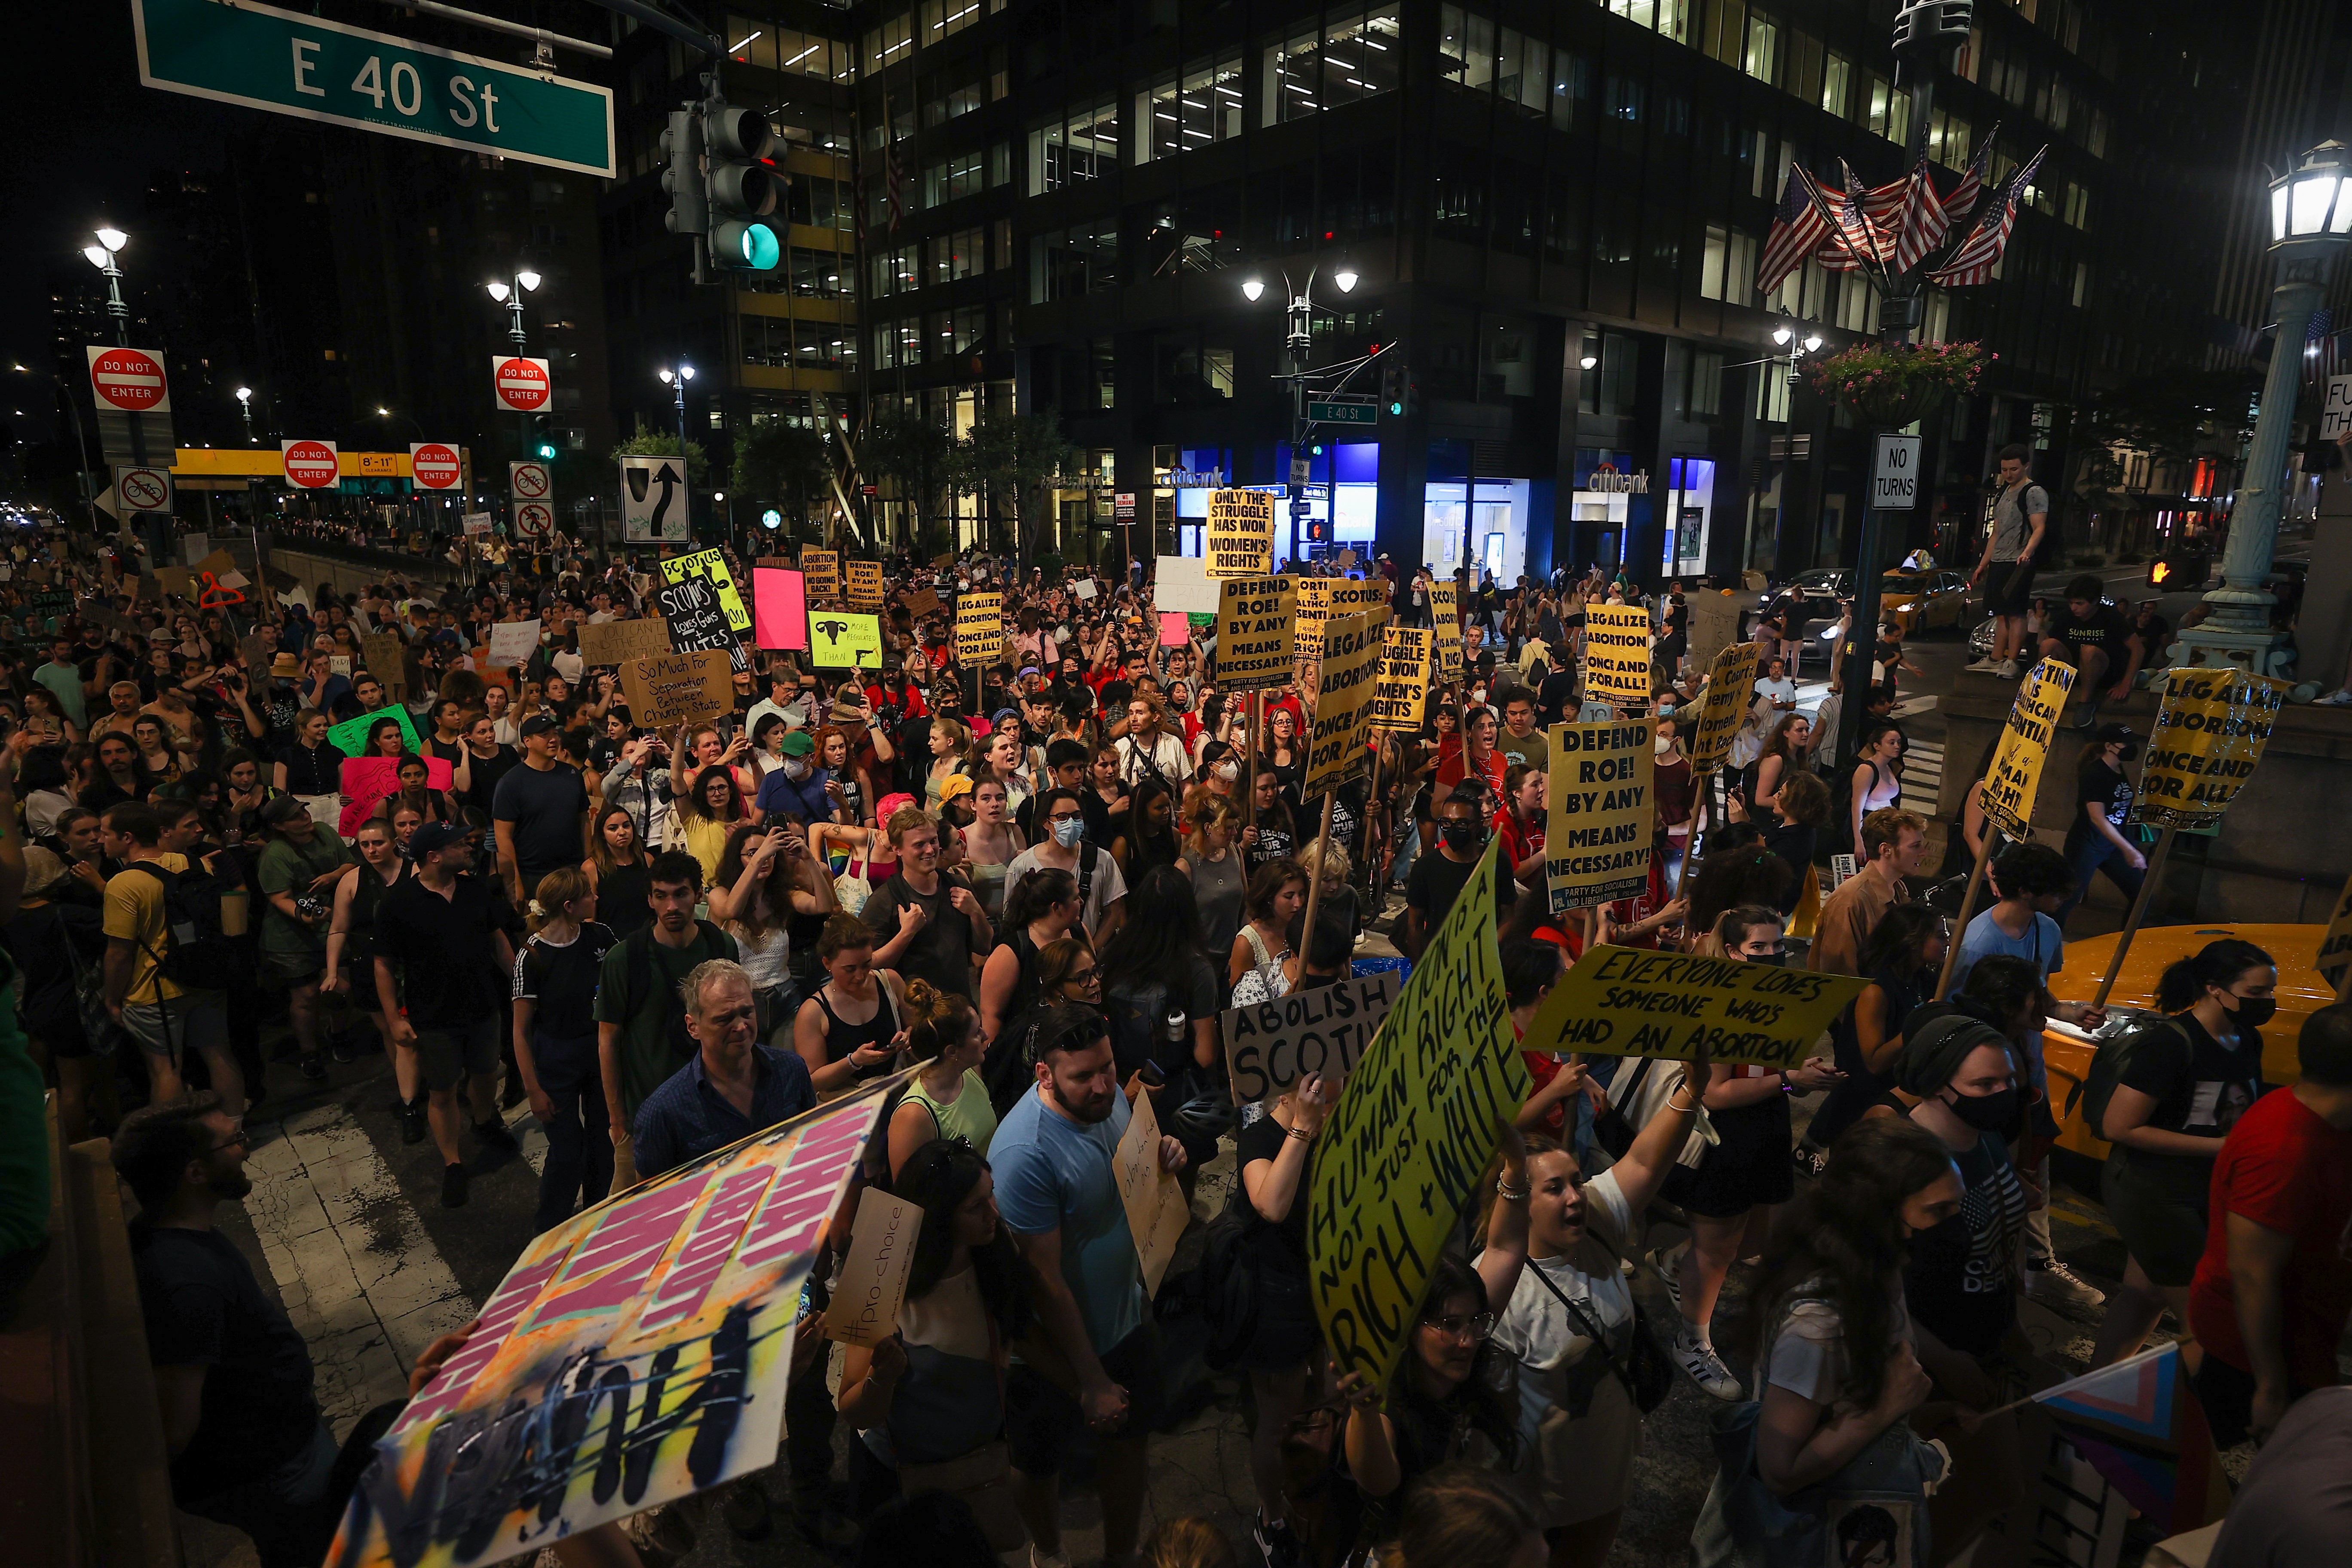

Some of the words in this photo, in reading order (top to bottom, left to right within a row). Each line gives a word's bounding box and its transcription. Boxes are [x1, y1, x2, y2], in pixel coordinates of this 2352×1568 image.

[292, 37, 325, 97] E
[352, 56, 421, 116] 40
[449, 76, 499, 133] St
[391, 122, 442, 136] TRANSPORTATION
[104, 361, 120, 371] DO
[126, 363, 150, 372] NOT
[505, 369, 517, 377] DO
[521, 370, 539, 378] NOT
[111, 388, 151, 398] ENTER
[509, 391, 539, 400] ENTER
[1328, 407, 1332, 418] E
[1336, 407, 1346, 419] 40
[1350, 408, 1358, 419] St
[1889, 448, 1907, 469] NO
[1296, 464, 1304, 472] NO
[1291, 474, 1308, 482] TURNS
[1589, 468, 1650, 494] citibank
[1877, 477, 1914, 497] TURNS
[1215, 491, 1243, 504] ONLY
[1246, 492, 1266, 505] THE
[1211, 505, 1269, 519] STRUGGLE
[1214, 519, 1237, 531] HAS
[1240, 519, 1266, 533] WON
[1210, 538, 1268, 553] WOMEN'S
[804, 554, 836, 563] ABORTION
[1216, 554, 1260, 568] RIGHTS
[805, 564, 810, 573] IS
[1228, 579, 1289, 597] DEFEND
[1332, 589, 1382, 603] SCOTUS:
[31, 592, 63, 605] STAY
[661, 579, 711, 616] SCOTUS
[958, 598, 1001, 610] LEGALIZE
[35, 603, 76, 616] FIGHT
[1237, 598, 1278, 616] ROE!
[958, 612, 1000, 624] ABORTION
[1230, 620, 1252, 634] BY
[1254, 616, 1287, 632] ANY
[1586, 612, 1646, 628] LEGALIZE
[600, 625, 623, 640] YOU
[851, 623, 869, 631] MORE
[2069, 628, 2104, 637] SUNRISE
[640, 633, 667, 645] CLIT
[847, 633, 876, 641] REGULATED
[958, 632, 982, 643] ONCE
[983, 630, 1001, 639] AND
[1400, 631, 1423, 646] THE
[1588, 632, 1646, 647] ABORTION
[589, 650, 614, 664] JUST
[619, 649, 636, 661] SAY
[638, 645, 664, 658] THAT
[959, 644, 979, 655] FOR
[980, 641, 1000, 652] ALL!
[1232, 640, 1281, 655] MEANS
[1743, 644, 1757, 661] the
[823, 652, 845, 661] THAN
[1217, 655, 1293, 673] NECESSARY!
[1588, 656, 1614, 671] ONCE
[1617, 661, 1648, 673] AND
[638, 662, 656, 680] So
[658, 657, 687, 677] Much
[692, 654, 710, 670] For
[1320, 655, 1380, 695] ABORTION
[1390, 662, 1419, 677] WON
[649, 675, 707, 697] Separation
[1260, 674, 1283, 683] SOCIALISM
[1589, 672, 1612, 688] FOR
[1614, 677, 1646, 690] ALL!
[656, 691, 704, 709] Between
[644, 704, 684, 723] Church
[692, 699, 721, 713] State
[1313, 710, 1353, 741] ONCE
[1563, 726, 1647, 752] DEFEND
[1310, 740, 1341, 772] FOR
[2145, 750, 2205, 775] ONCE
[2203, 759, 2254, 778] AND
[1579, 756, 1634, 783] ROE!
[845, 781, 856, 793] GOD
[1566, 791, 1598, 814] BY
[1601, 786, 1645, 812] ANY
[1568, 823, 1636, 849] MEANS
[1547, 847, 1650, 878] NECESSARY!
[1841, 857, 1851, 873] FIGHT
[1565, 887, 1589, 897] PARTY
[1591, 885, 1604, 894] FOR
[1605, 879, 1637, 892] SOCIALISM
[1553, 898, 1565, 909] PSL
[1567, 897, 1578, 908] AND
[1580, 891, 1617, 906] LIBERATION
[1592, 951, 1758, 989] EVERYONE
[1752, 968, 1832, 1002] LOVES
[1234, 980, 1388, 1042] ABOLISH
[1599, 986, 1713, 1019] SOMEONE
[1724, 998, 1785, 1026] WHO'S
[1314, 922, 1451, 1188] ABORTION
[1473, 871, 1488, 912] A
[1557, 1018, 1614, 1044] HAD
[1626, 1023, 1673, 1054] AN
[1313, 1052, 1409, 1260] HUMAN
[1418, 913, 1487, 1079] RIGHT
[1319, 1204, 1363, 1308] NOT
[1375, 1107, 1417, 1203] JUST
[1427, 1047, 1461, 1114] FOR
[1464, 978, 1499, 1046] THE
[739, 1099, 878, 1268] WHAT
[1329, 1198, 1426, 1376] RICH
[1427, 999, 1526, 1214] WHITE
[530, 1170, 714, 1326] MY
[638, 1166, 776, 1329] ABOUT
[840, 1207, 903, 1341] #pro-choice
